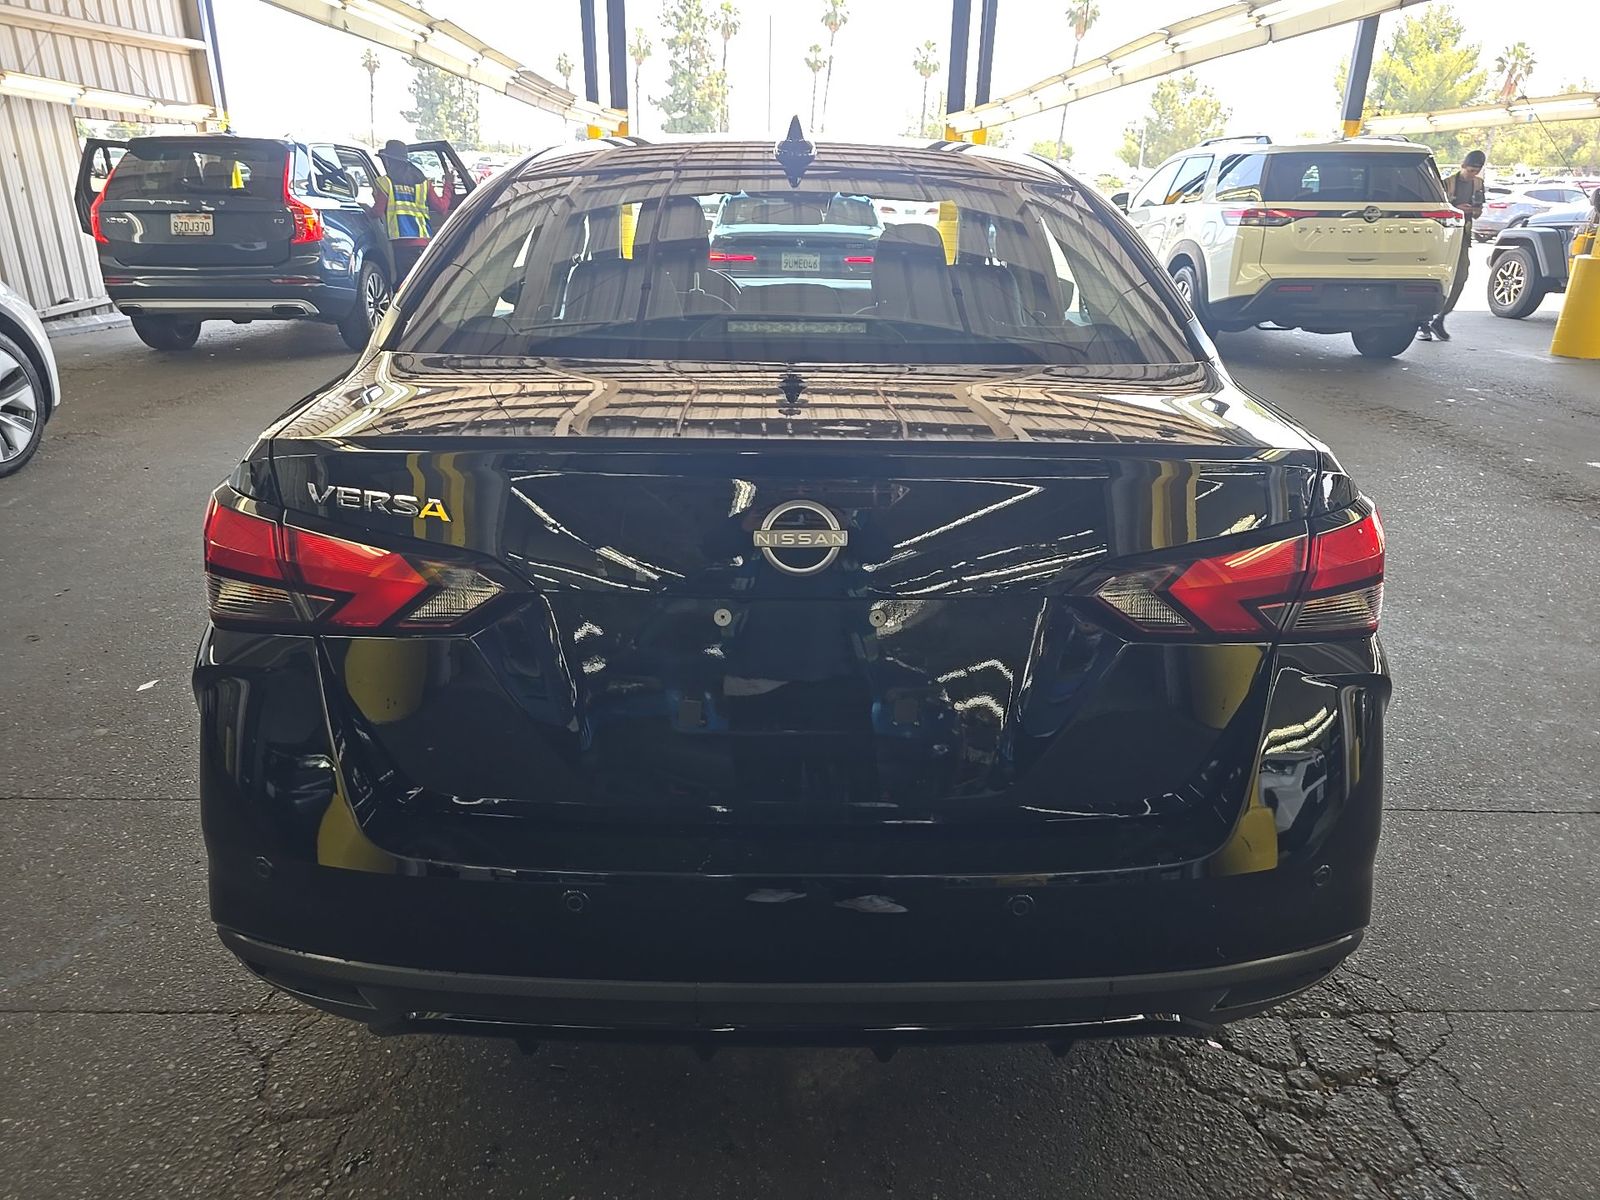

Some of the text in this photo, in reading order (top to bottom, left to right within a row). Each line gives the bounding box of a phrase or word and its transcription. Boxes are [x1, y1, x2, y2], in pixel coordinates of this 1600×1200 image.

[173, 221, 210, 232] 8ZDJ370
[306, 481, 453, 523] VERSA
[755, 533, 845, 545] NISSAN
